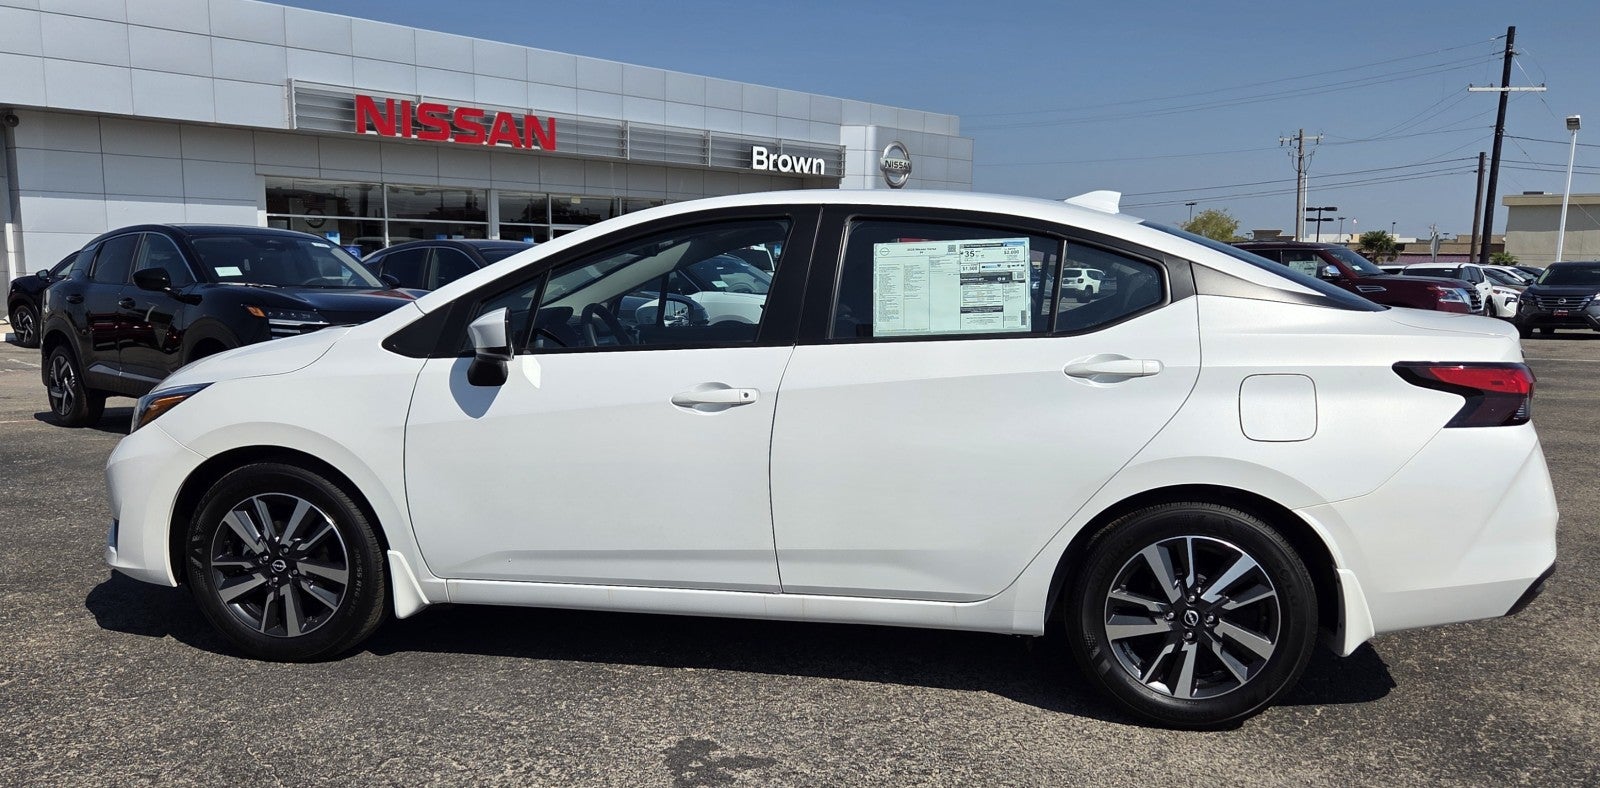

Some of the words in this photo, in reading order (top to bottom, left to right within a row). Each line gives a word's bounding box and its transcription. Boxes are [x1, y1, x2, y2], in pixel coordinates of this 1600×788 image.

[355, 94, 556, 151] NISSAN
[752, 145, 825, 175] Brown
[964, 250, 975, 258] 35
